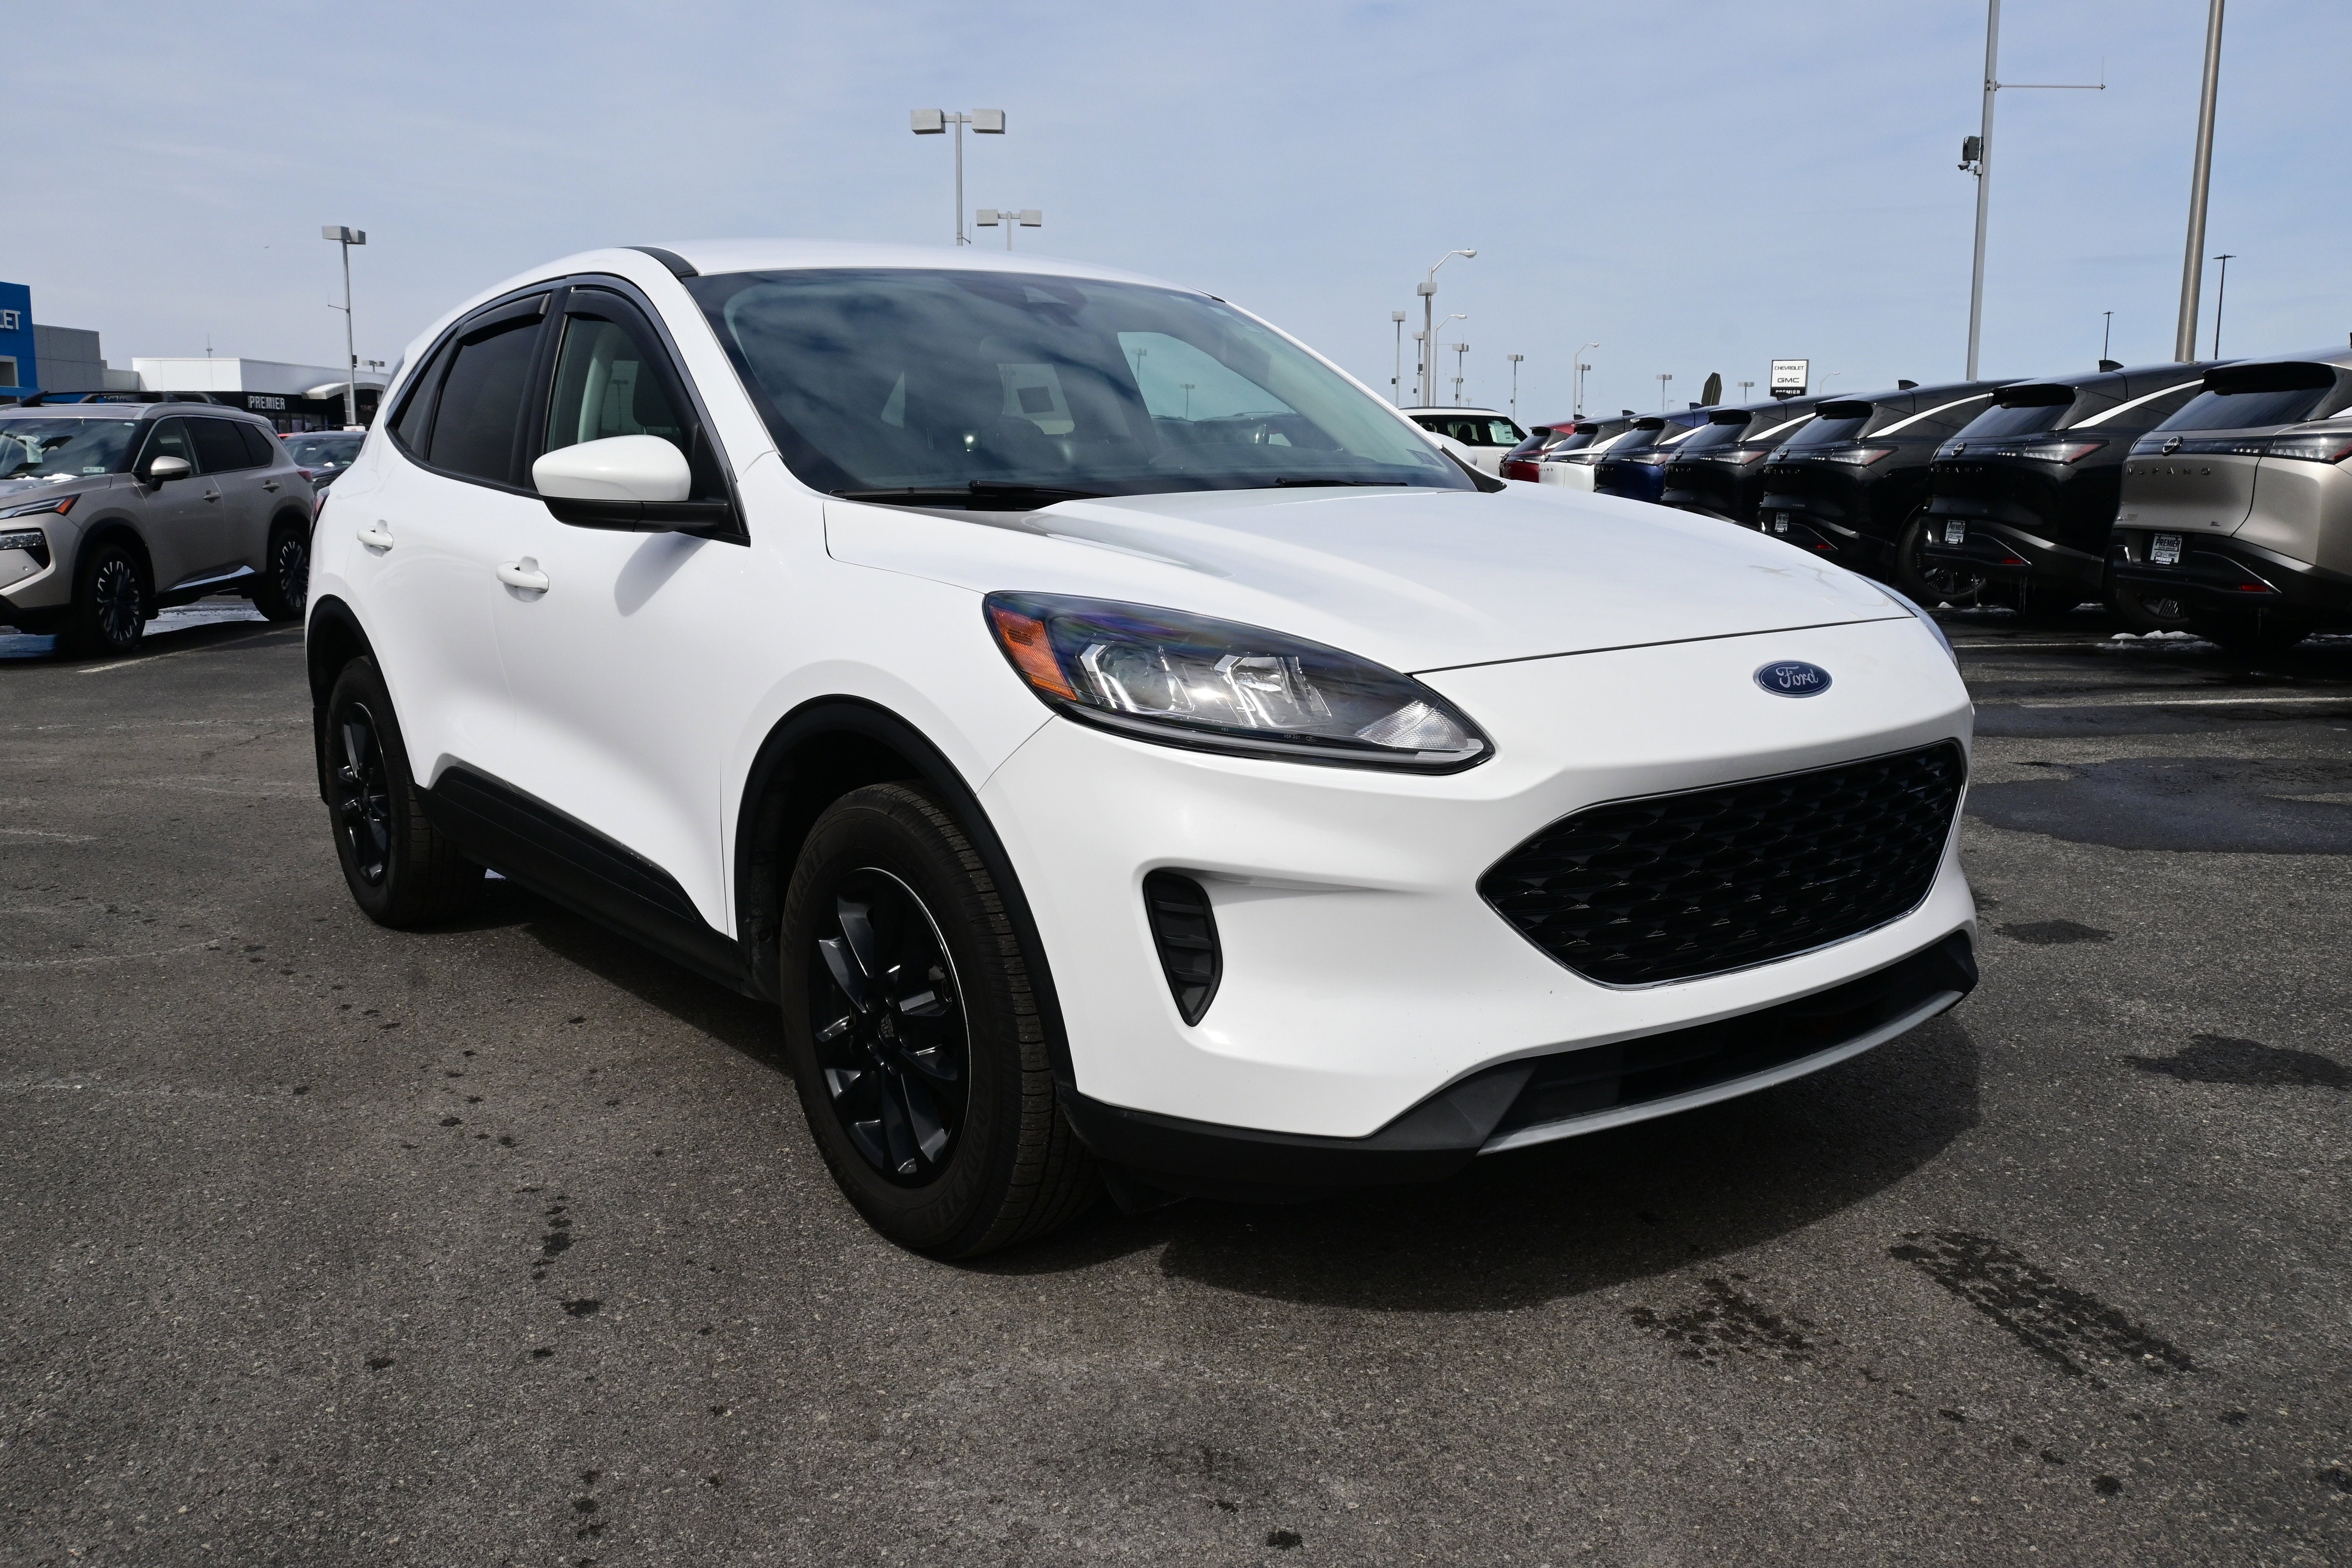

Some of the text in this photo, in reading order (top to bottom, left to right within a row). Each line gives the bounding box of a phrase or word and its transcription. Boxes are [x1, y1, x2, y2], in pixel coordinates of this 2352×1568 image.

[248, 395, 285, 410] PREMIER
[2156, 539, 2180, 547] PREMIER
[1776, 666, 1818, 689] Ford
[781, 836, 826, 956] RELIANT
[913, 1072, 990, 1234] GOODYEAR
